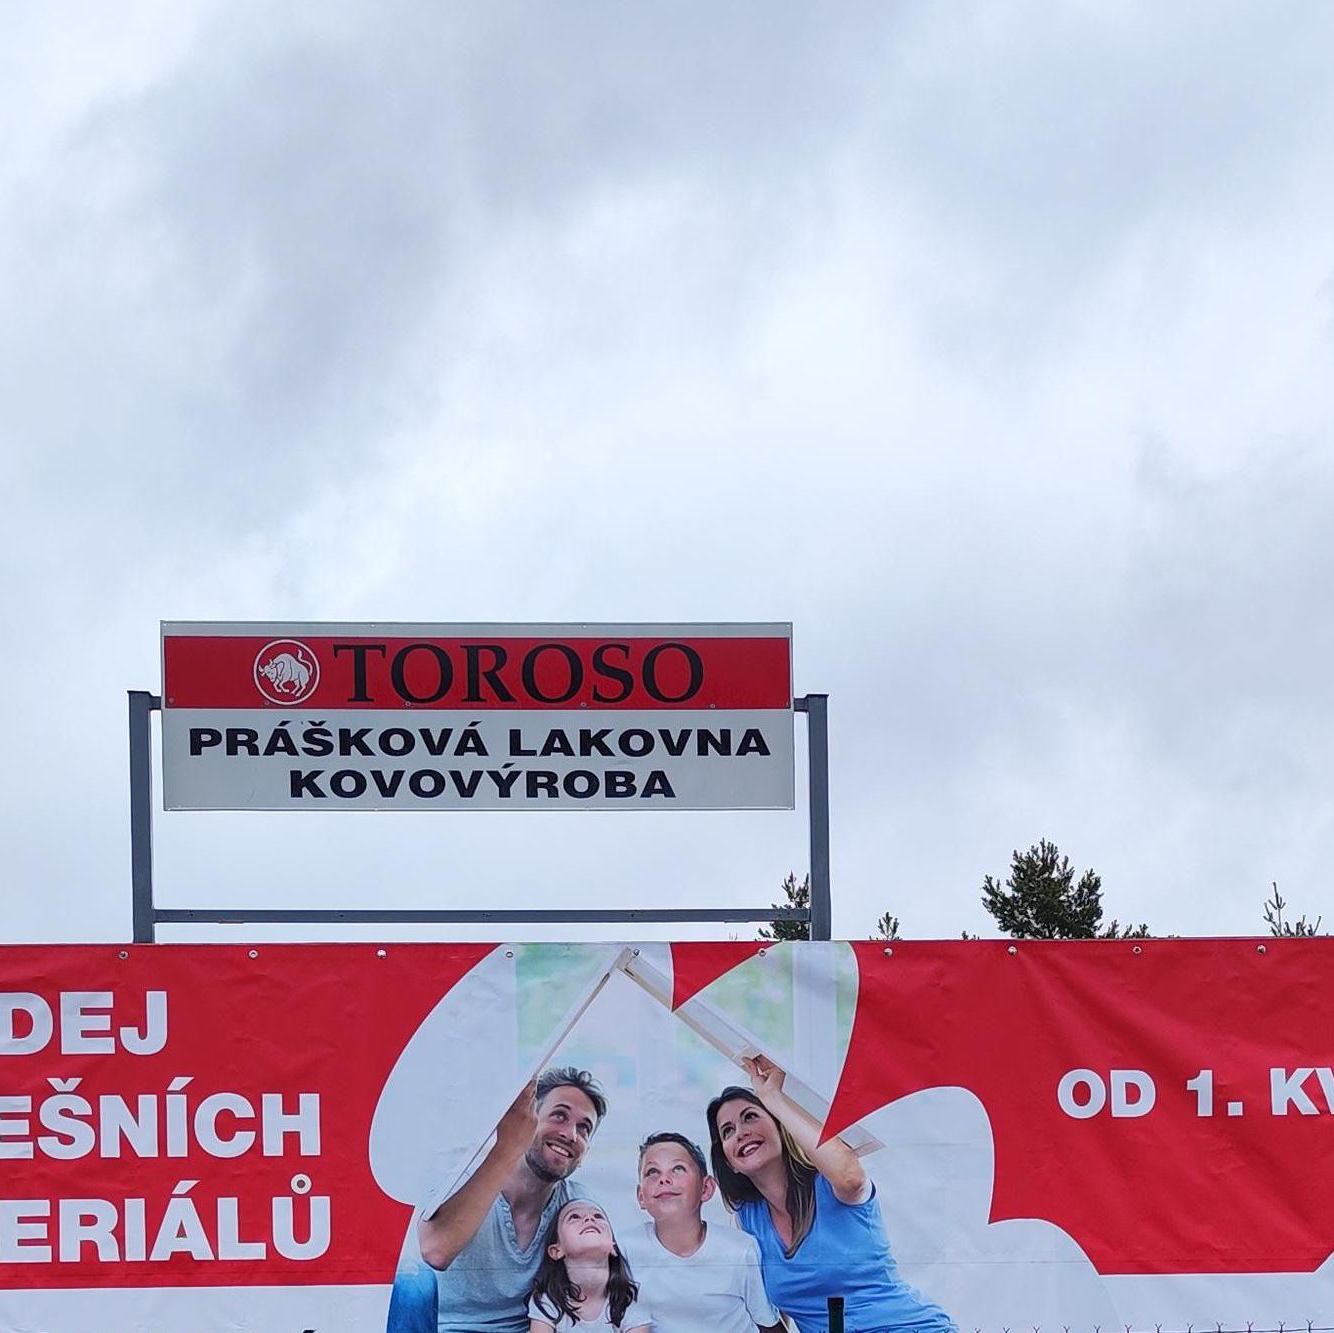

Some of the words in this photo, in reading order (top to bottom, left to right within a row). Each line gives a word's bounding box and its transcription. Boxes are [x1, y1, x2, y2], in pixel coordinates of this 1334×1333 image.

[332, 643, 704, 704] TOROSO
[188, 720, 492, 757] PRÁŠKOVÁ
[508, 728, 771, 757] LAKOVNA
[290, 762, 677, 799] KOVOVÝROBA
[1057, 1068, 1157, 1119] OD
[1186, 1069, 1244, 1117] 1.
